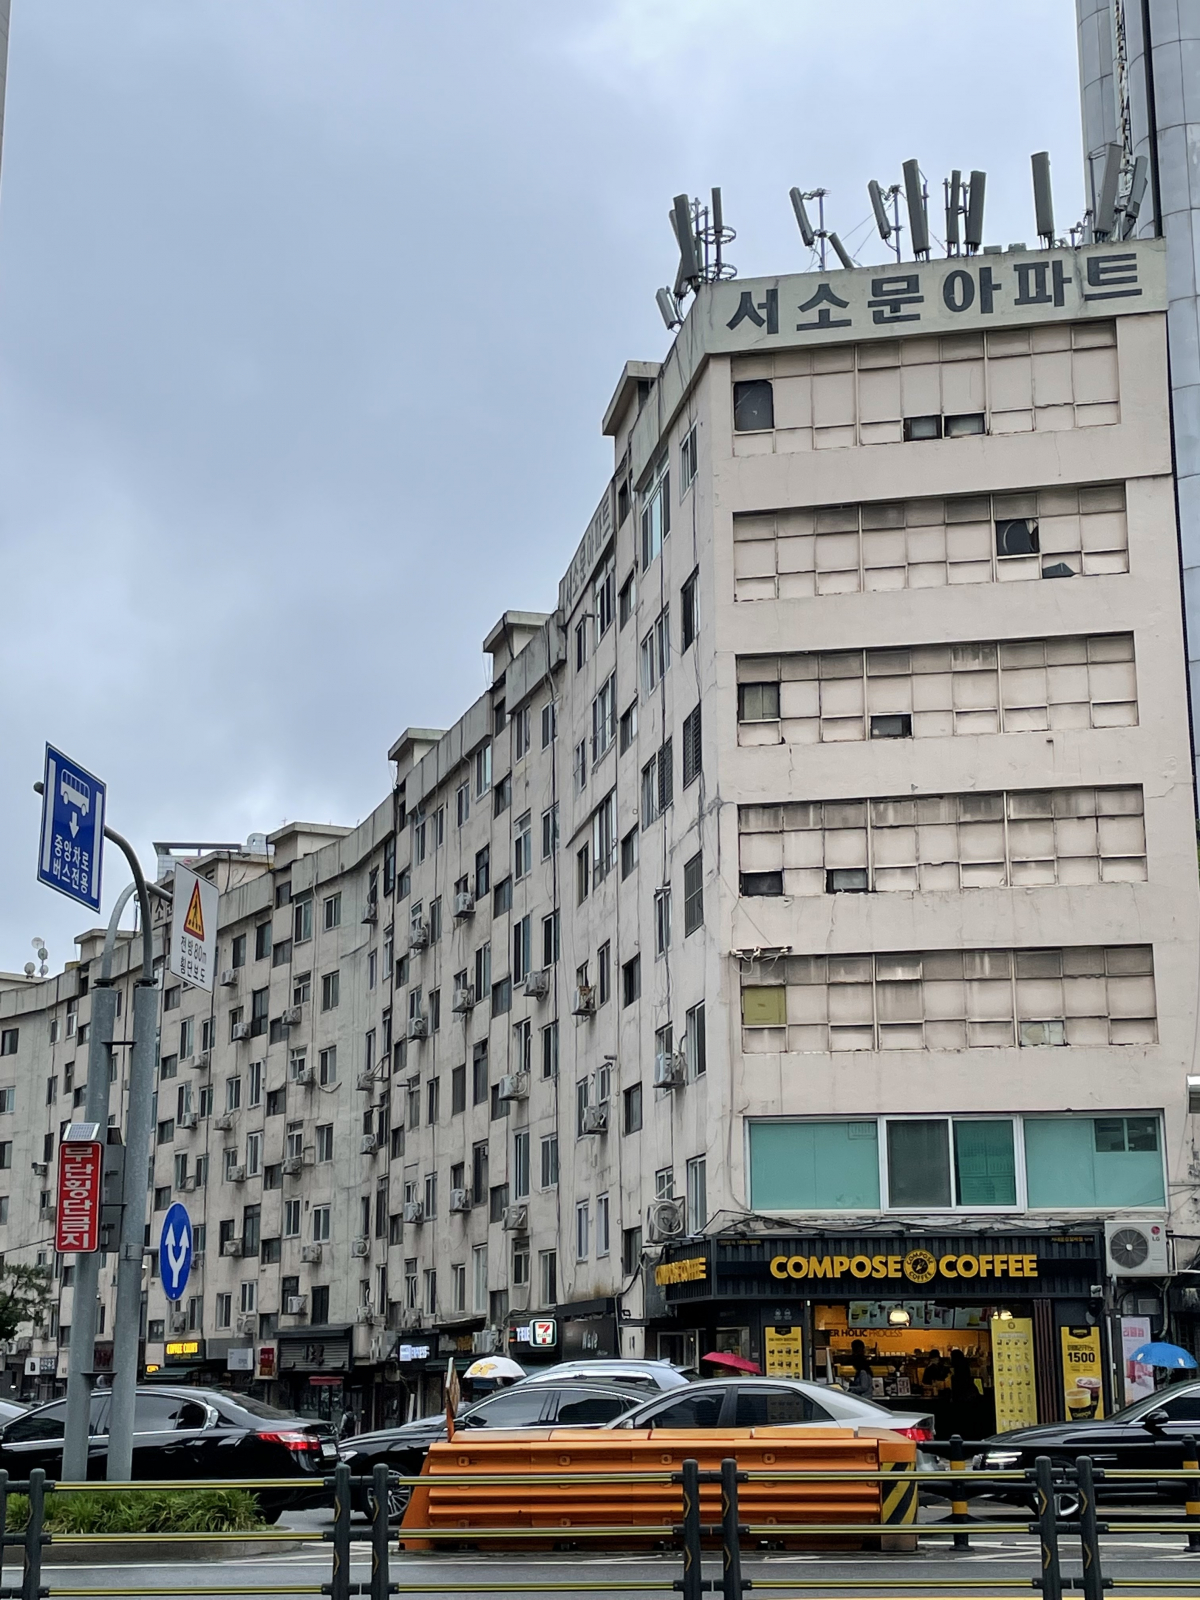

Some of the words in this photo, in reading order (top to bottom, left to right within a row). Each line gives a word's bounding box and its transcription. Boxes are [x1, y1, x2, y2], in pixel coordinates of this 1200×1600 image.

[726, 252, 1143, 336] 서소문아파트
[54, 833, 90, 872] 중앙차로
[52, 857, 89, 894] 버스전용
[179, 955, 206, 984] 횡단보도
[61, 1146, 95, 1249] 무단횡단금지
[769, 1255, 903, 1279] COMPOSE
[938, 1254, 1039, 1279] COFFEE
[906, 1251, 934, 1266] COMPOSE
[908, 1271, 933, 1282] COFFEE
[841, 1328, 868, 1338] HOLIC
[868, 1329, 903, 1338] PROCESS
[1067, 1351, 1096, 1364] 1500
